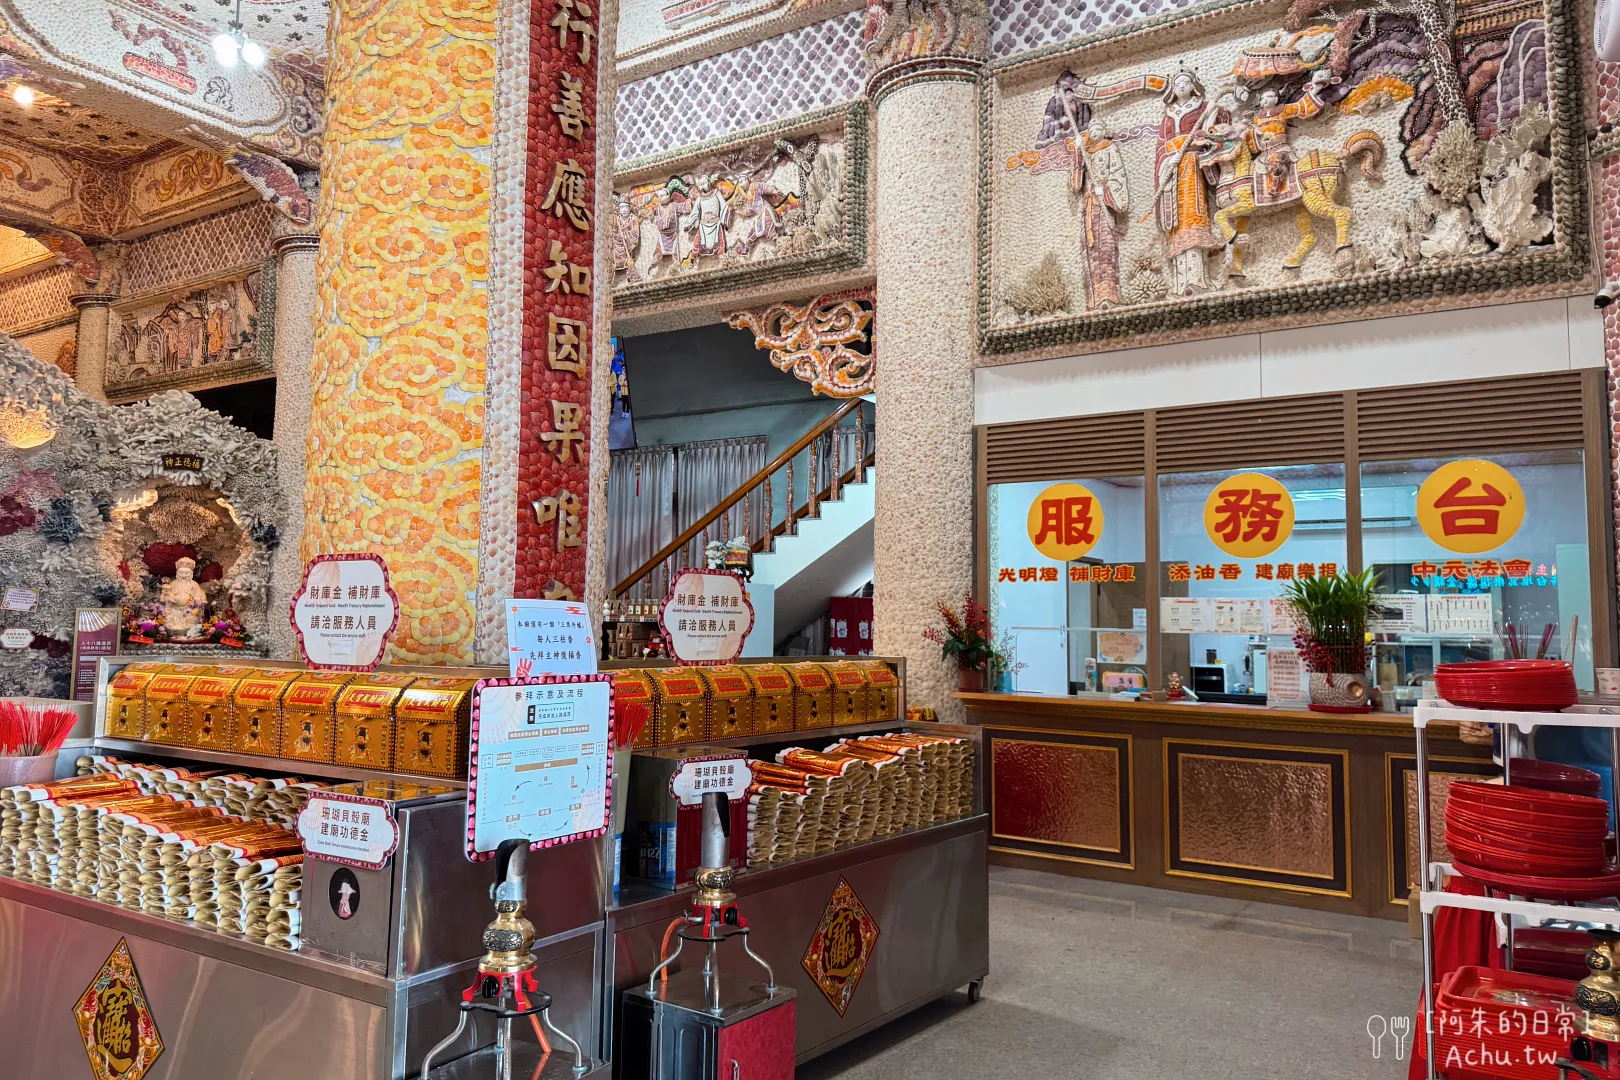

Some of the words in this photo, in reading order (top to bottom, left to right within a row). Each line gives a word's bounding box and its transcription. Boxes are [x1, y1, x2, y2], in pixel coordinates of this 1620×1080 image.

[1035, 497, 1094, 545] 服
[1214, 489, 1284, 543] 務
[1433, 477, 1507, 536] 台
[998, 566, 1059, 583] 光明燈
[1069, 565, 1136, 582] 補財庫
[1169, 563, 1242, 582] 添油香
[1255, 562, 1338, 581] 建廟樂捐
[1411, 558, 1532, 579] 中元法會
[310, 586, 342, 600] 財庫金
[347, 585, 381, 600] 補財庫
[677, 594, 706, 606] 財庫金
[711, 595, 739, 607] 補財庫
[310, 615, 377, 630] 請洽服務人員
[678, 619, 736, 631] 請洽服務人員
[515, 688, 584, 702] 參拜示意及流程
[695, 765, 734, 778] 珊瑚貝殼廟
[694, 776, 734, 790] 建廟功德金
[322, 806, 370, 826] 珊瑚貝殼廟
[320, 822, 369, 842] 建廟功德金
